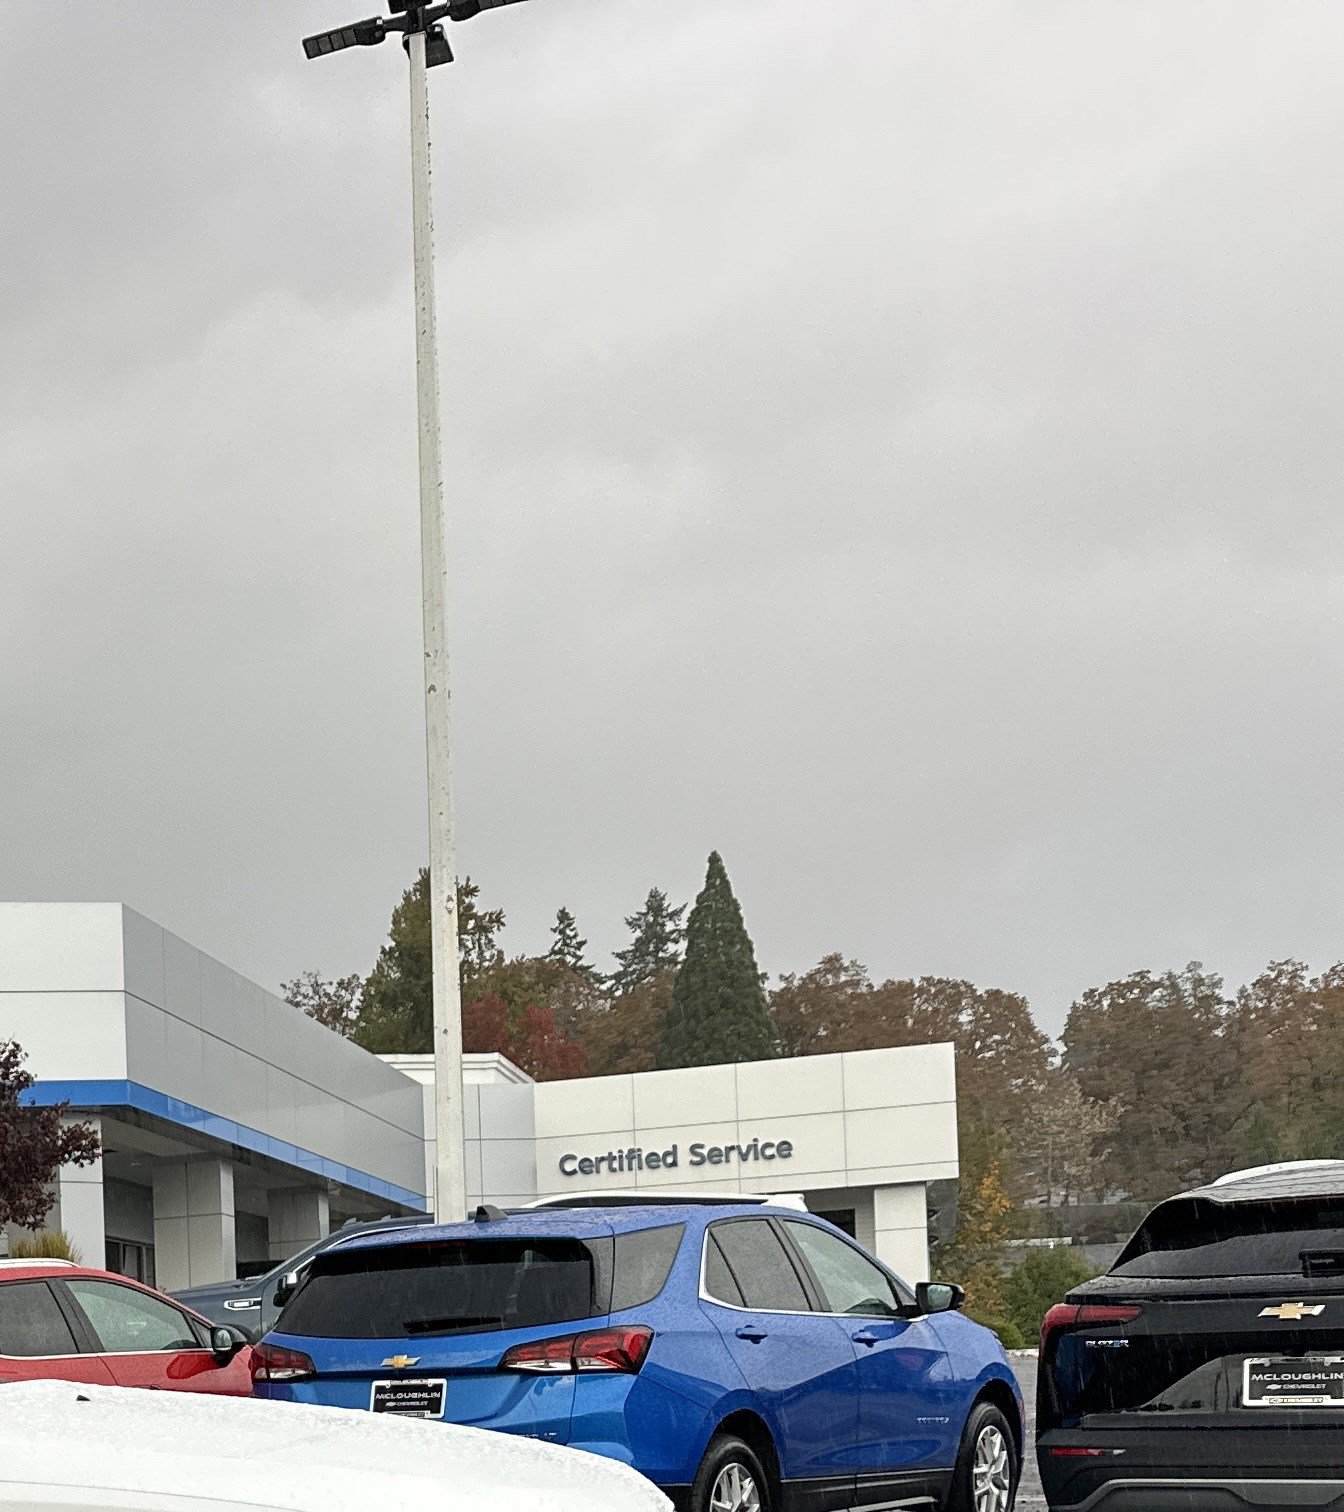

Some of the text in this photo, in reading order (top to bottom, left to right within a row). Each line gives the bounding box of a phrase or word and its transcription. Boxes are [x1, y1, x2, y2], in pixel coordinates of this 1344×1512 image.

[558, 1138, 794, 1177] Certified Service
[1251, 1373, 1344, 1381] MCLOUGHLIN
